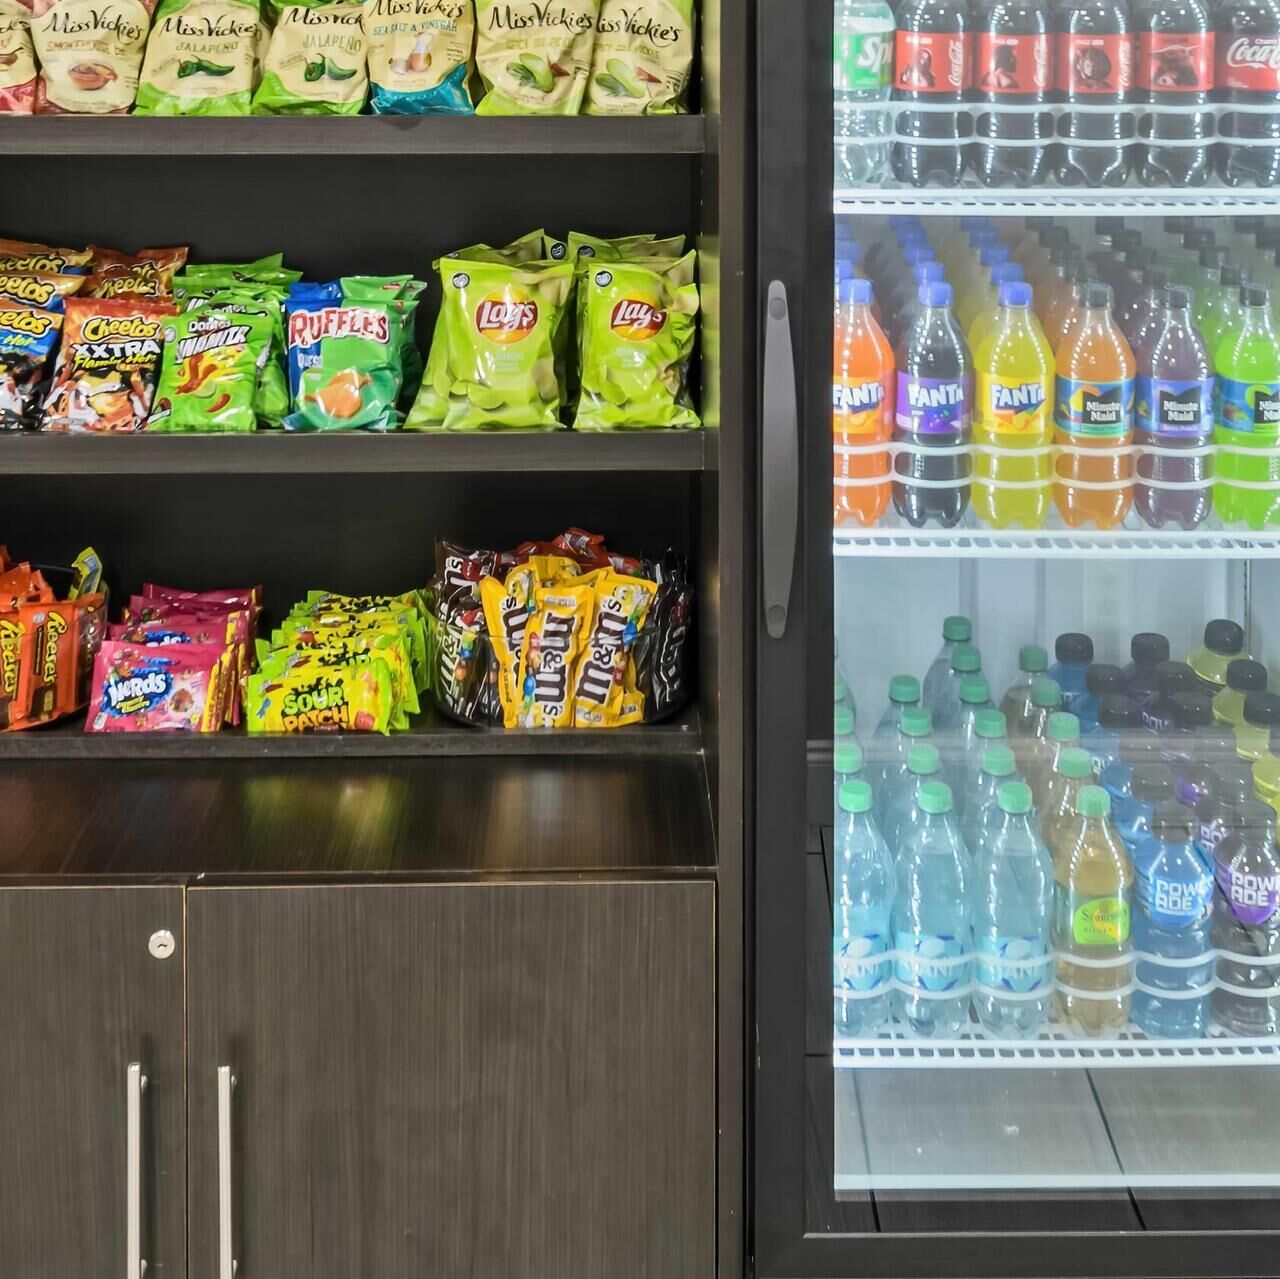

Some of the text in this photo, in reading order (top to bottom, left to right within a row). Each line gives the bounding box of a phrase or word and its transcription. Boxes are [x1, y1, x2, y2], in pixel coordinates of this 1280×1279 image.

[42, 5, 144, 41] Miss Vickie's
[159, 16, 204, 36] Miss
[286, 7, 330, 26] Miss
[488, 4, 535, 31] Miss
[596, 6, 684, 47] iss Vickie's
[81, 315, 162, 343] Cheetos
[289, 306, 390, 348] RUFFLES
[479, 301, 536, 331] Lay's
[70, 339, 162, 359] XXTRA
[1086, 401, 1121, 412] Minute
[1090, 411, 1117, 422] Maid
[43, 610, 69, 685] Reese's
[575, 596, 628, 705] m&m's
[107, 672, 167, 706] Nerds
[283, 686, 345, 715] SOUR
[283, 702, 350, 732] PATCH
[1155, 895, 1193, 912] ADE
[1230, 888, 1269, 907] ADE
